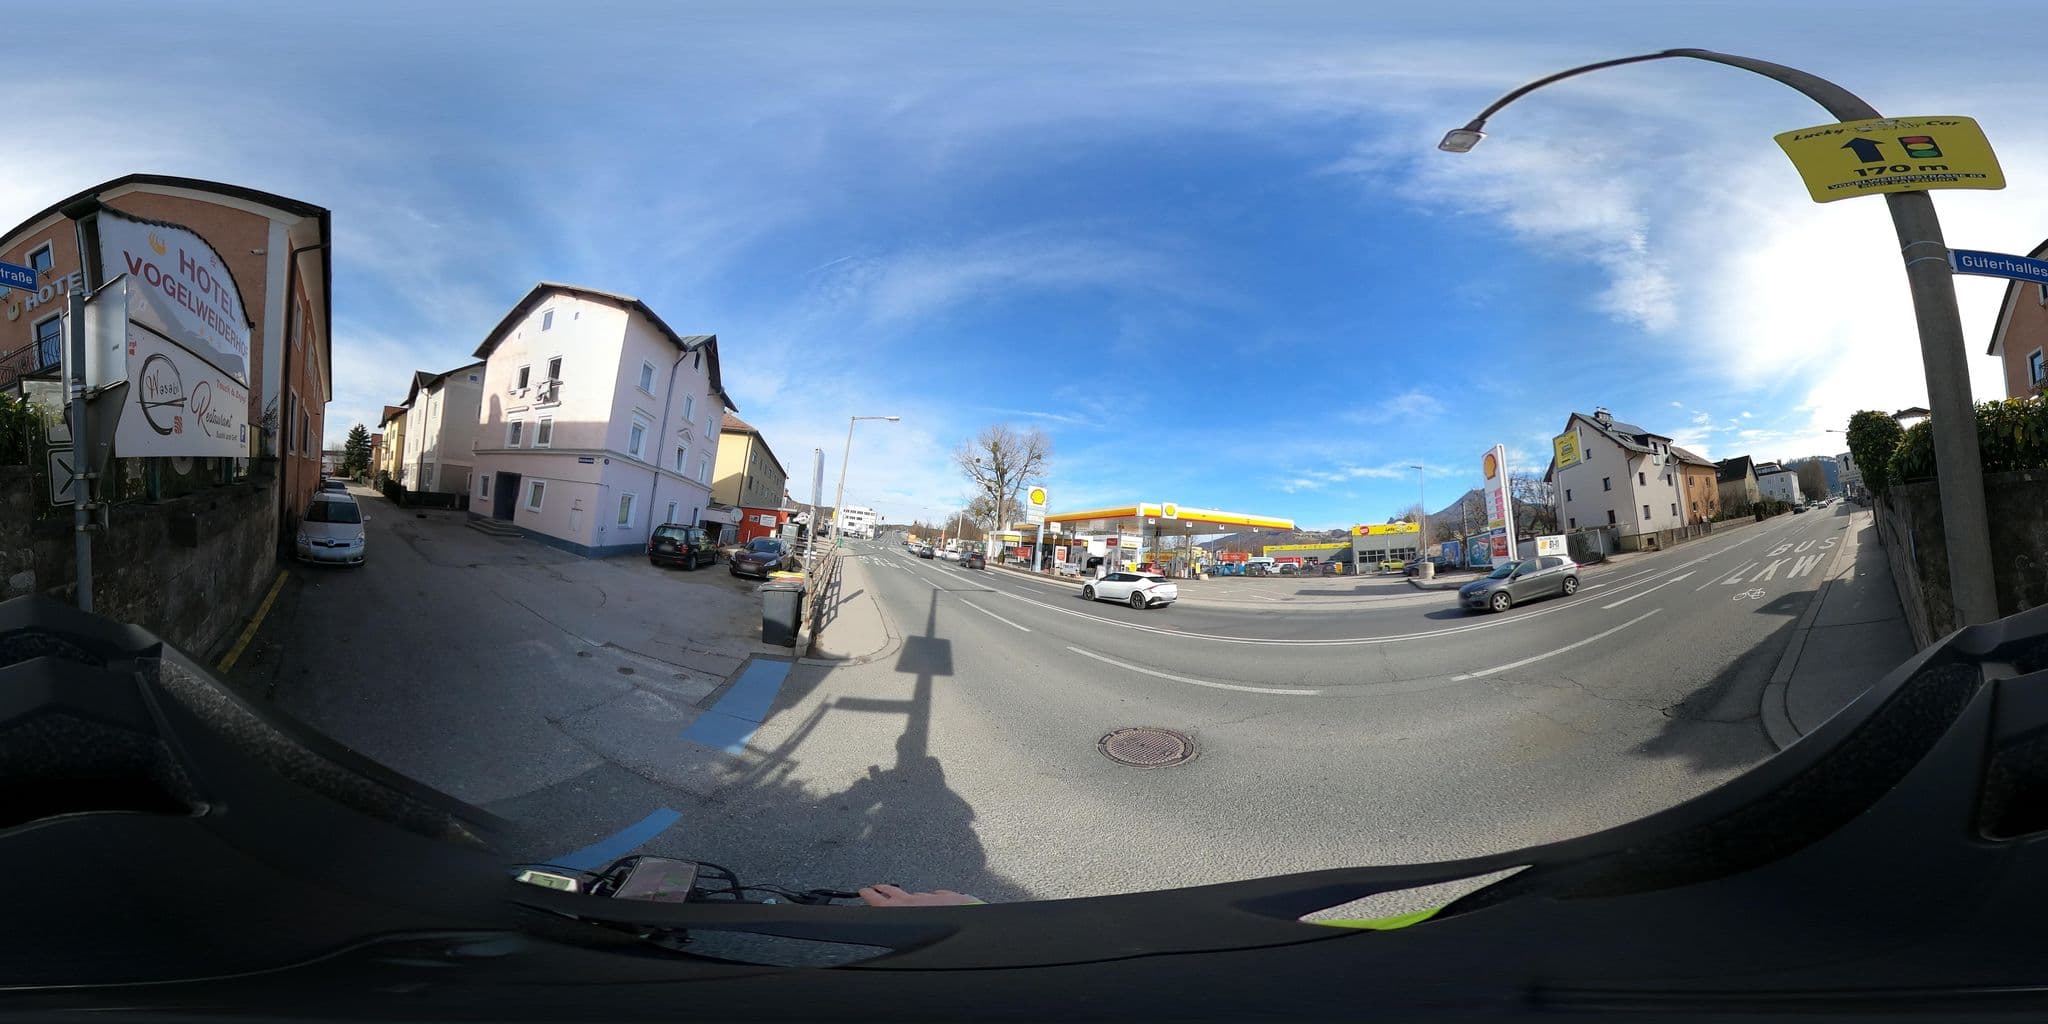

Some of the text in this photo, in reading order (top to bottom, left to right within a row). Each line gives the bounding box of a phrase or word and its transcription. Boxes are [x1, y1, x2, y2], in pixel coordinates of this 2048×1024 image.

[1793, 128, 1845, 142] Lucky
[1854, 164, 1912, 177] 170
[1961, 255, 2048, 277] Güterhalles
[25, 270, 82, 312] HOTE
[179, 248, 236, 322] HOTEL
[146, 369, 180, 399] Wasabi
[191, 381, 233, 438] Restaurant
[1766, 536, 1839, 557] BUS
[1720, 553, 1826, 585] LKW
